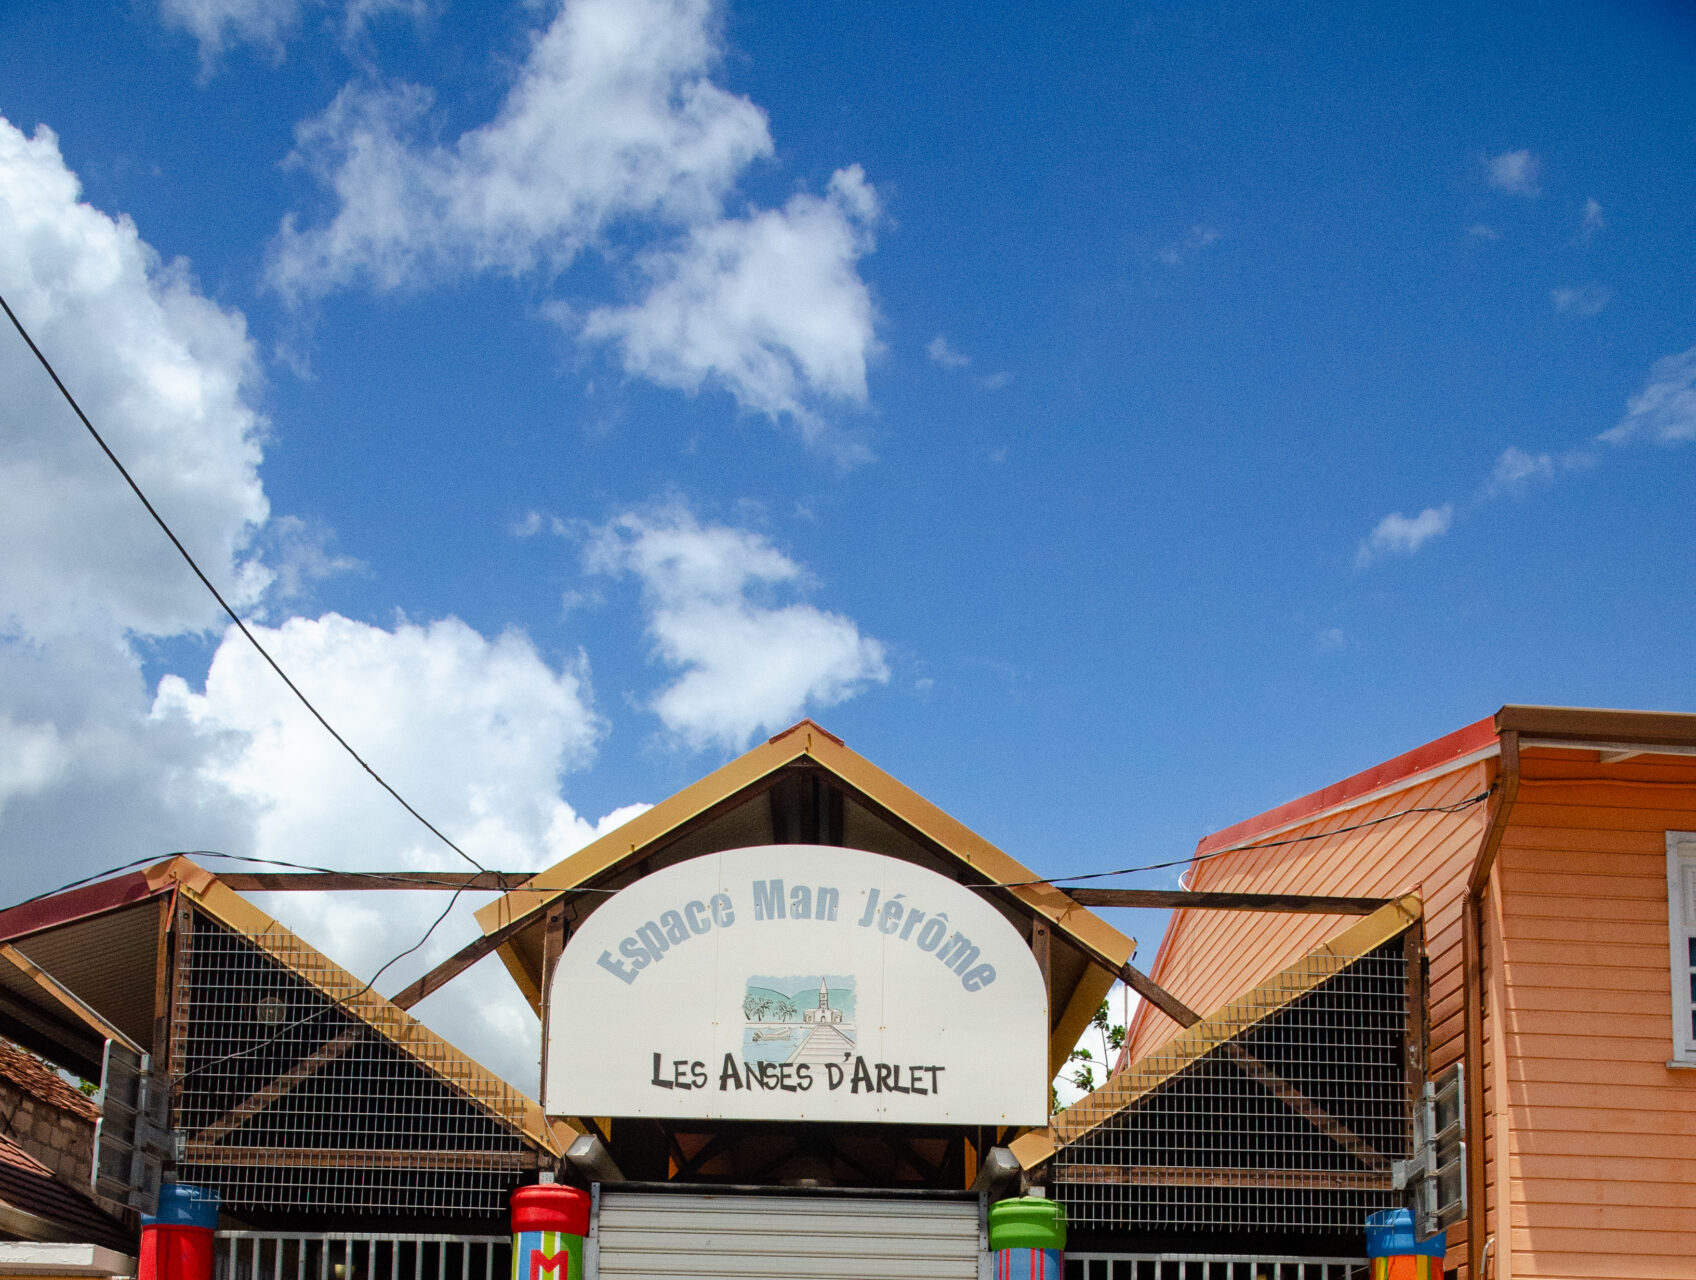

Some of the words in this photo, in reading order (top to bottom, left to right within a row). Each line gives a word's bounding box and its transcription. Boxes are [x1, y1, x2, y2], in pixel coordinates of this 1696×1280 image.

[596, 892, 736, 986] Espace
[752, 878, 840, 922] Man
[857, 887, 998, 993] Jérôme
[651, 1052, 707, 1091] LES
[719, 1053, 813, 1093] ANSES
[825, 1052, 946, 1096] D'ARLET
